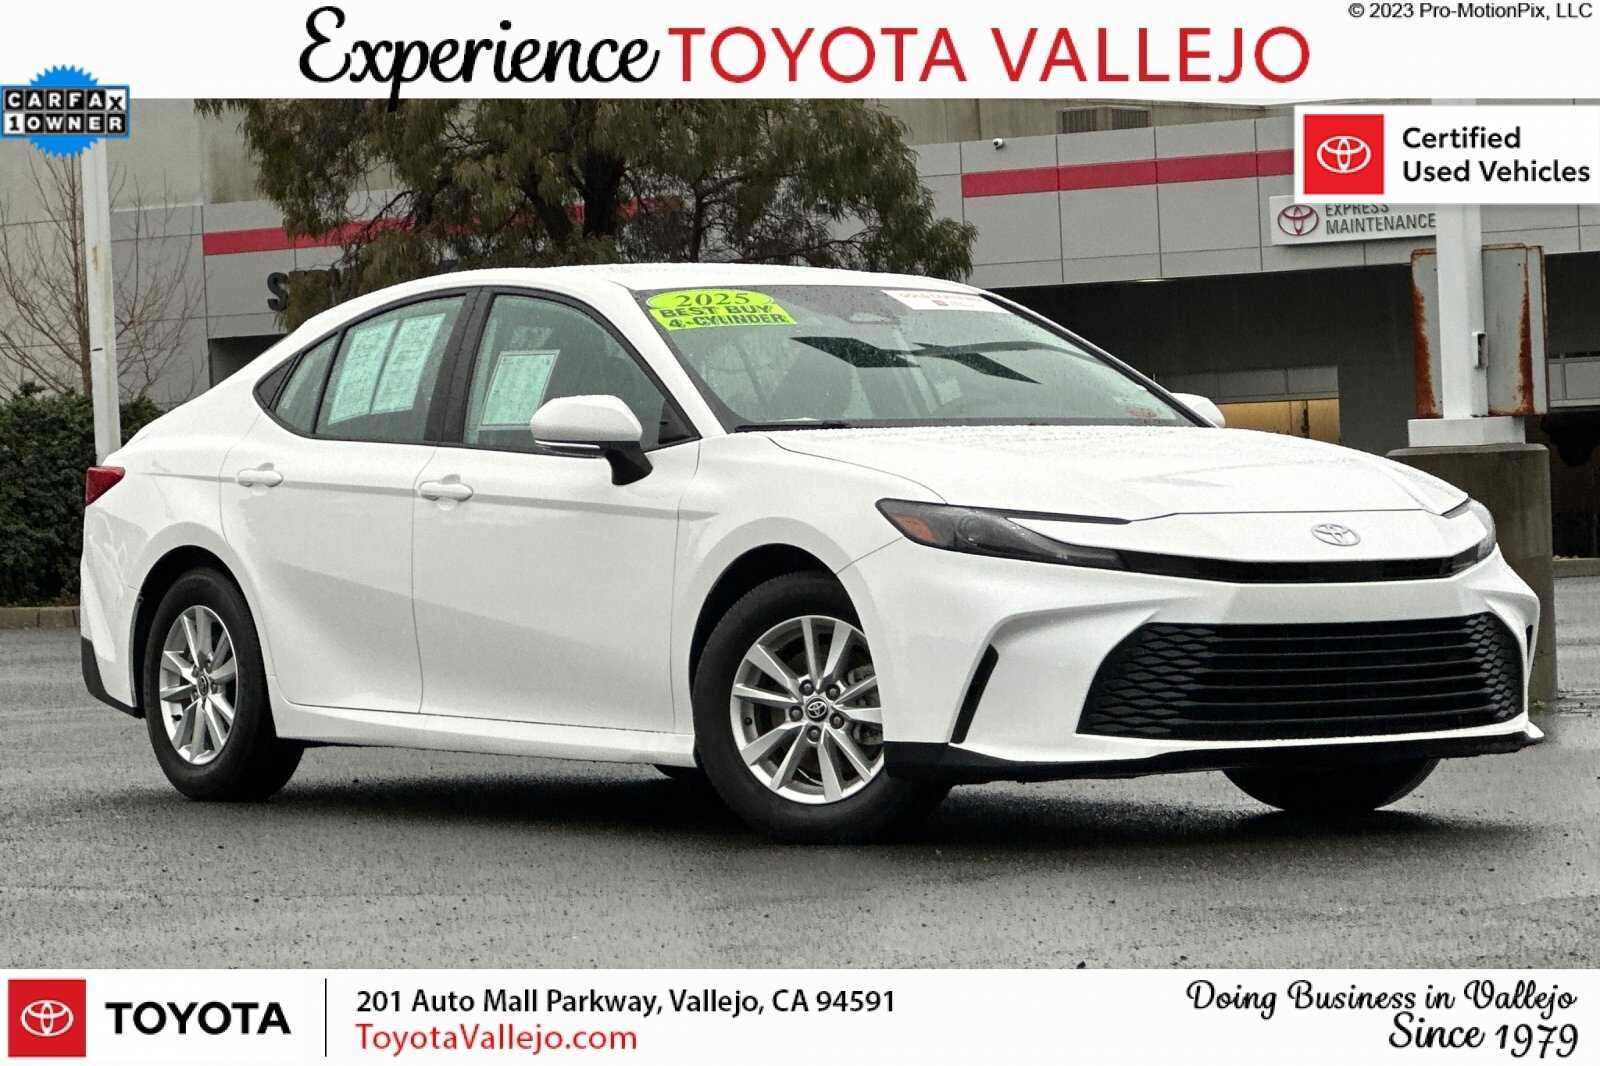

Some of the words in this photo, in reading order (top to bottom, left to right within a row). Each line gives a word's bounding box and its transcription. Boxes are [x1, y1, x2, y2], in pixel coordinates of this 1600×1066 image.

[1325, 203, 1390, 217] EXPRESS
[1325, 213, 1437, 235] MAINTENANCE
[674, 293, 751, 307] 2025
[659, 305, 718, 318] BEST
[726, 303, 772, 315] BUY
